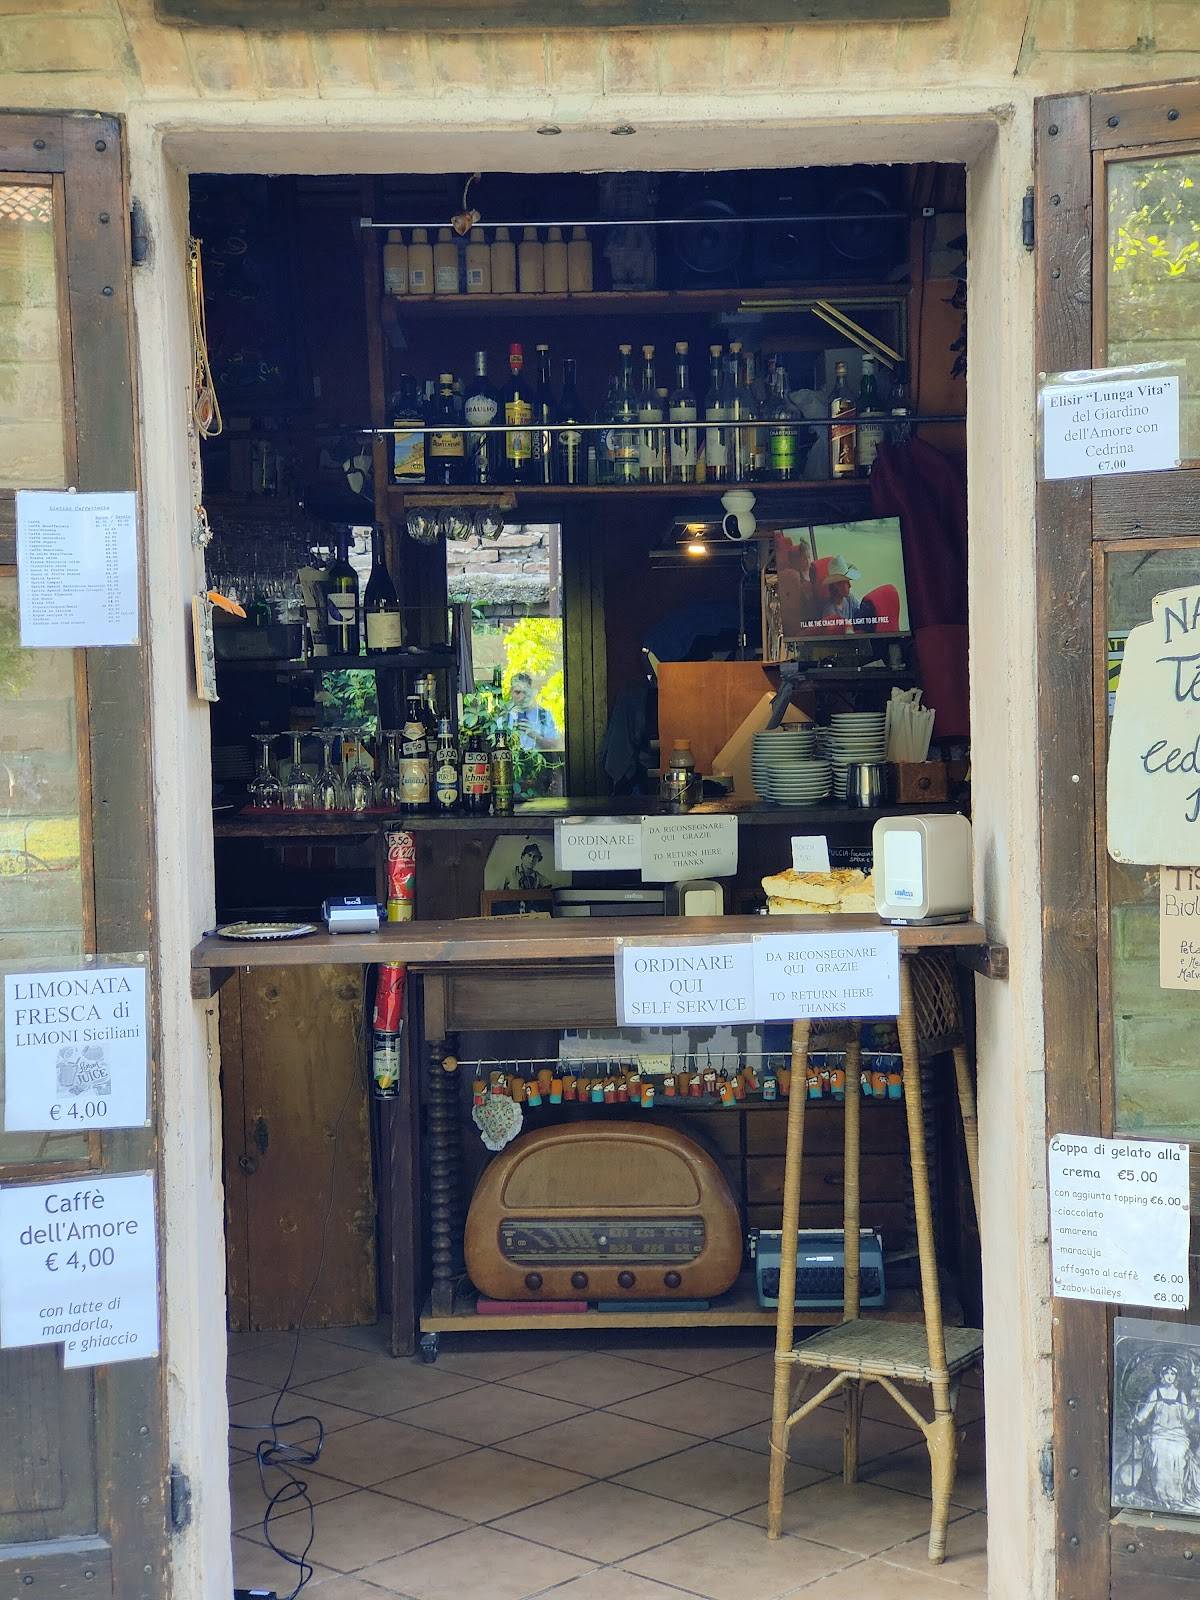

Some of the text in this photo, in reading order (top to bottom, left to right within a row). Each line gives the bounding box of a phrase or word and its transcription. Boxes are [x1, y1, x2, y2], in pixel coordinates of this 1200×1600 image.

[1050, 395, 1082, 408] Elisir
[1072, 404, 1149, 422] del Giardino
[1064, 423, 1158, 442] dell'Amore con
[1086, 442, 1134, 457] Cedrina
[836, 618, 844, 626] FOR
[650, 822, 724, 834] DA RICONSEGNARE
[568, 834, 635, 846] ORDINARE
[661, 832, 712, 842] QUI GRAZIE
[588, 851, 611, 861] QUI
[666, 851, 698, 860] RETURN
[701, 848, 722, 856] HERE
[673, 859, 704, 868] THANKS
[766, 948, 876, 962] DA RICONSEGNARE
[634, 955, 734, 973] ORDINARE
[784, 961, 858, 976] QUI GRAZIE
[14, 976, 132, 1000] LIMONATA
[669, 978, 703, 996] QUI
[770, 987, 874, 1001] TO RETURN HERE
[16, 1001, 130, 1025] FRESCA di
[632, 997, 746, 1015] SELF SERVICE
[799, 1002, 846, 1013] THANKS
[16, 1024, 140, 1046] LIMONI Siciliani
[76, 1068, 108, 1085] JUICE
[50, 1100, 107, 1122] € 4,00
[1051, 1141, 1180, 1161] Coppa di gelato alla
[1062, 1167, 1158, 1183] crema €5.00
[45, 1189, 105, 1214] Caffè
[1055, 1189, 1181, 1207] con aggiunta topping €6.00
[20, 1220, 138, 1245] dell'Amore
[45, 1246, 114, 1272] € 4,00
[1102, 1269, 1110, 1277] al
[1113, 1270, 1139, 1281] caffè
[1153, 1274, 1184, 1284] €6.00
[1154, 1293, 1184, 1303] €8.00
[39, 1297, 121, 1318] con latte di
[42, 1318, 113, 1336] mandorla,
[68, 1332, 138, 1352] e ghiaccio
